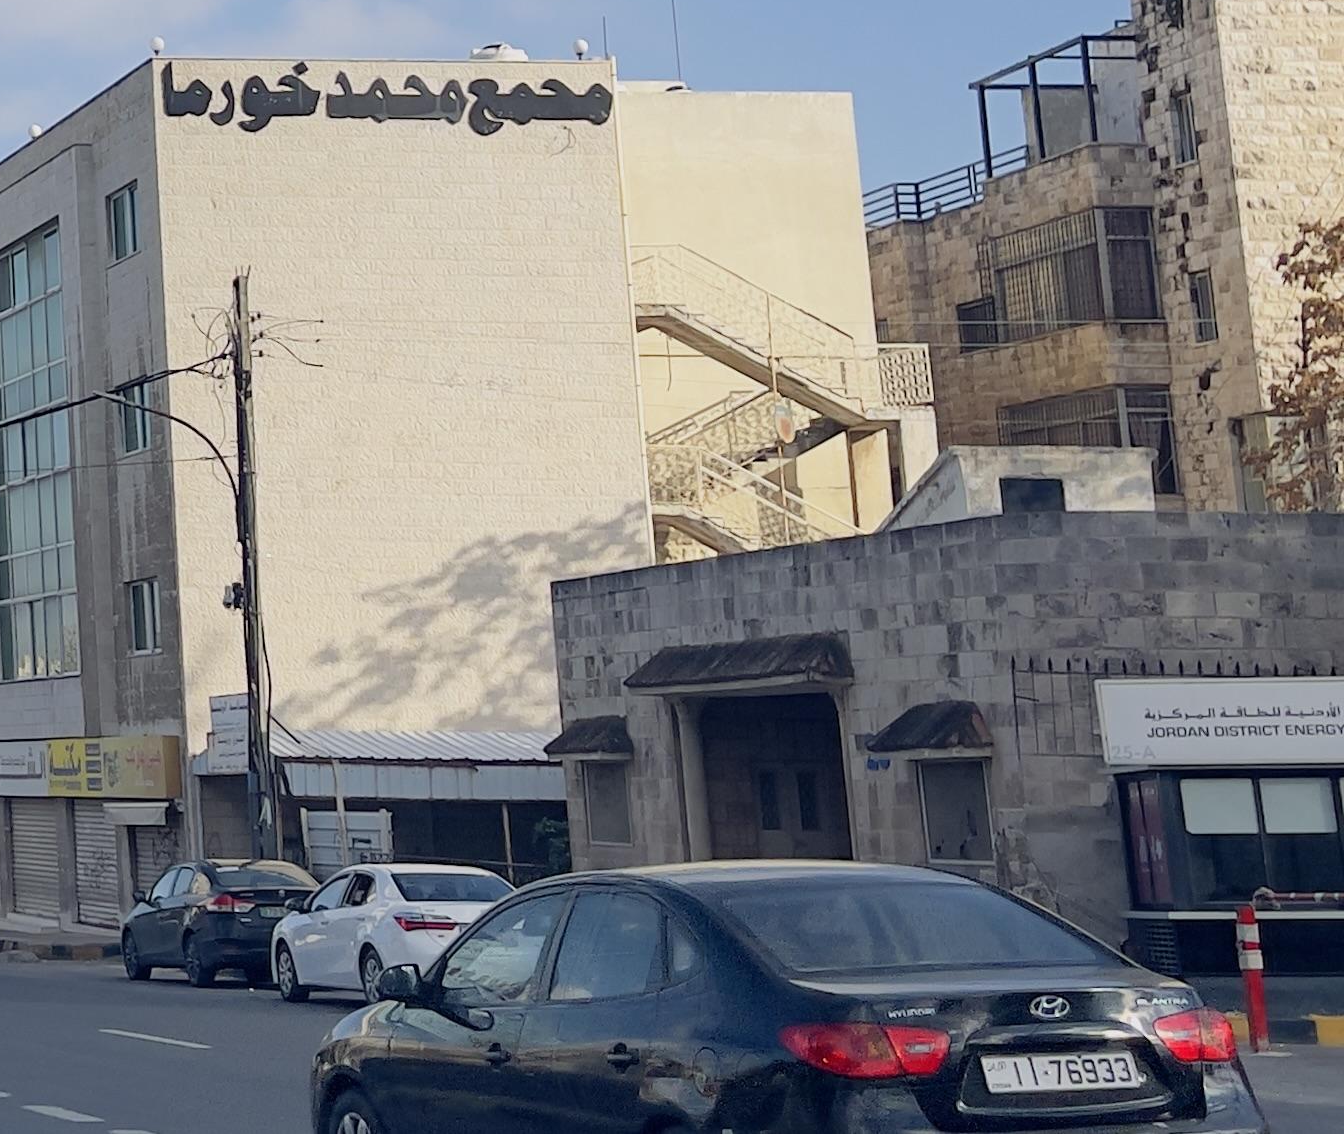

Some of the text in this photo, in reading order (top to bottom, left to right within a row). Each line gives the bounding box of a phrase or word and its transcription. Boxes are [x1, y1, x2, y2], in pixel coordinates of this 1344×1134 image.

[326, 71, 469, 125] محمد
[1145, 701, 1341, 721] الأردنية للطاقة المركزية
[1147, 724, 1344, 738] JORDAN DISTRICT ENERGY
[1112, 745, 1157, 760] 25-A
